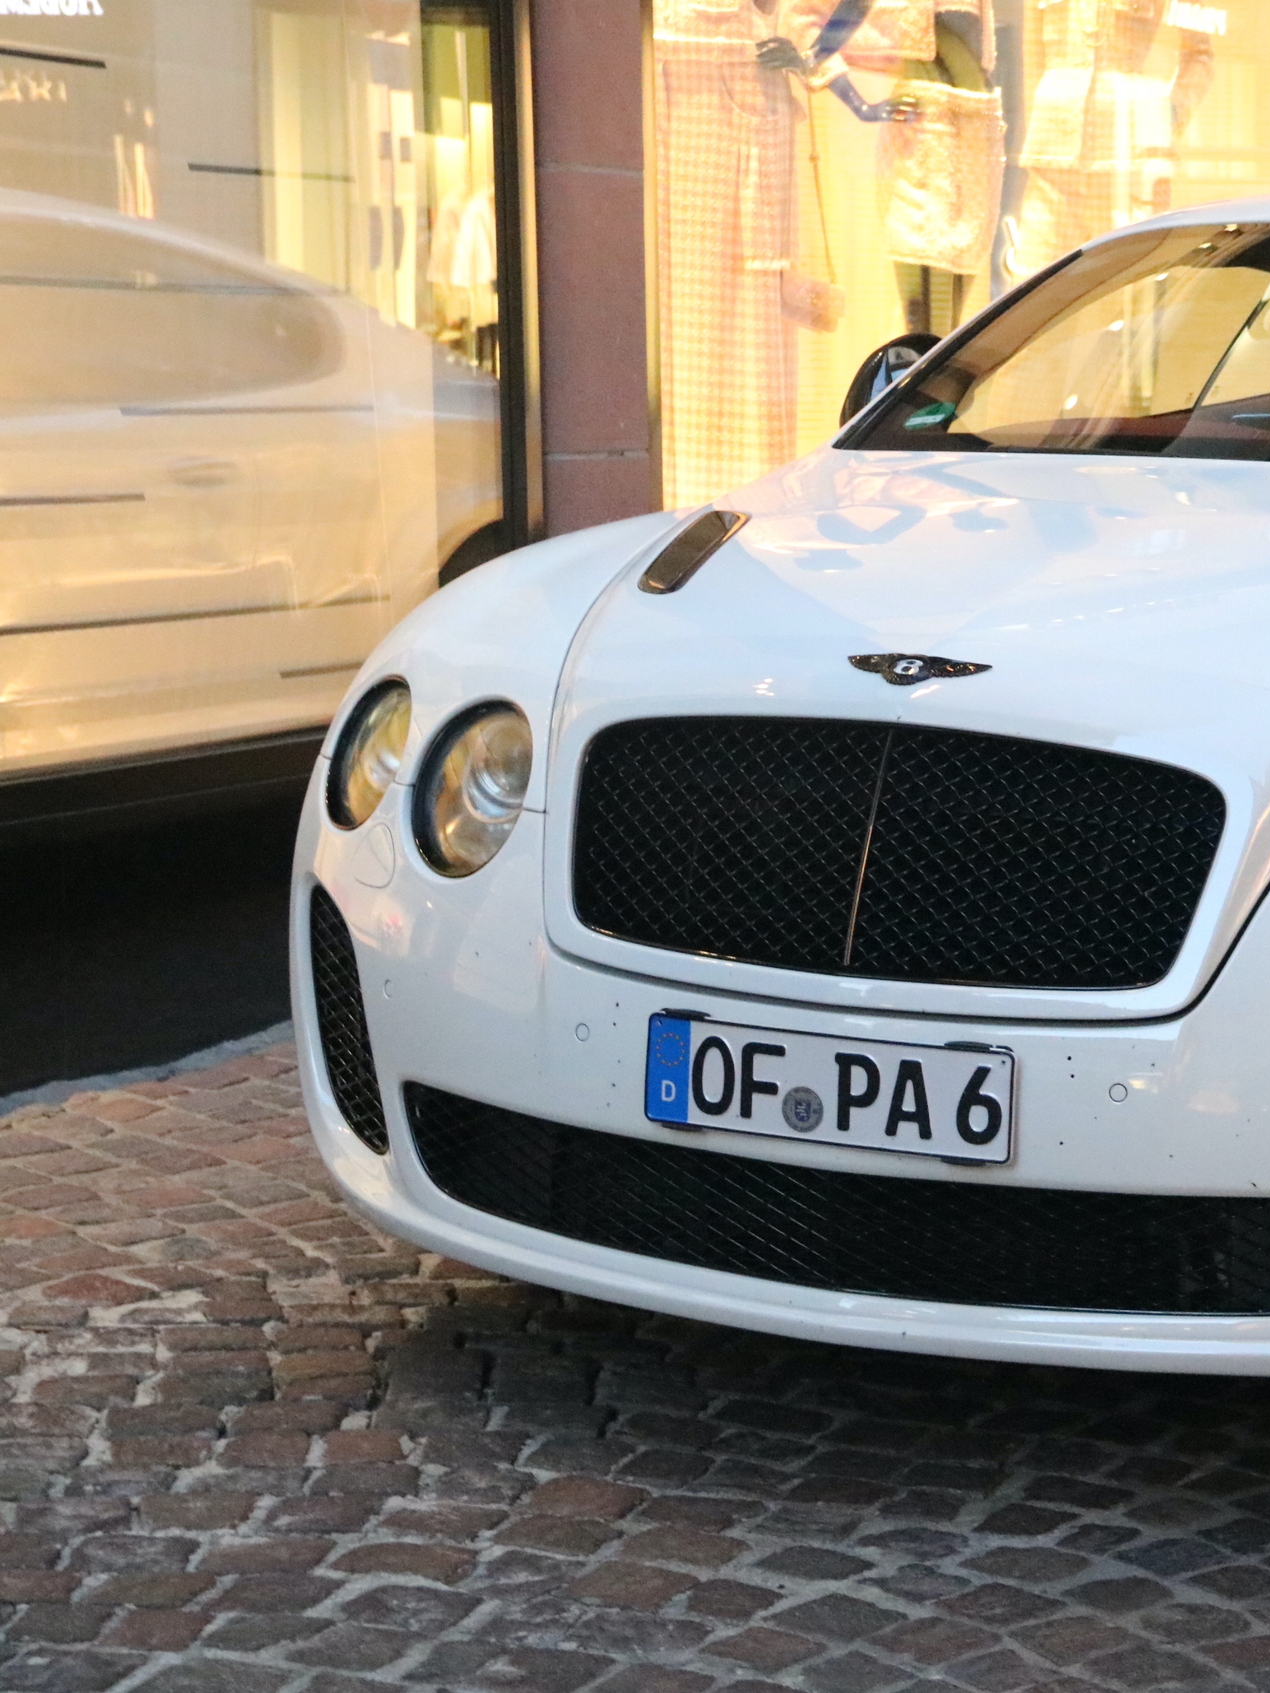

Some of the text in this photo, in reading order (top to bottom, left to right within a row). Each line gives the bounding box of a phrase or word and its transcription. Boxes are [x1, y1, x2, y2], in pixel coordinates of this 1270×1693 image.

[661, 1080, 676, 1102] D
[692, 1036, 786, 1118] OF
[835, 1052, 932, 1140] PA
[956, 1065, 1002, 1145] 6
